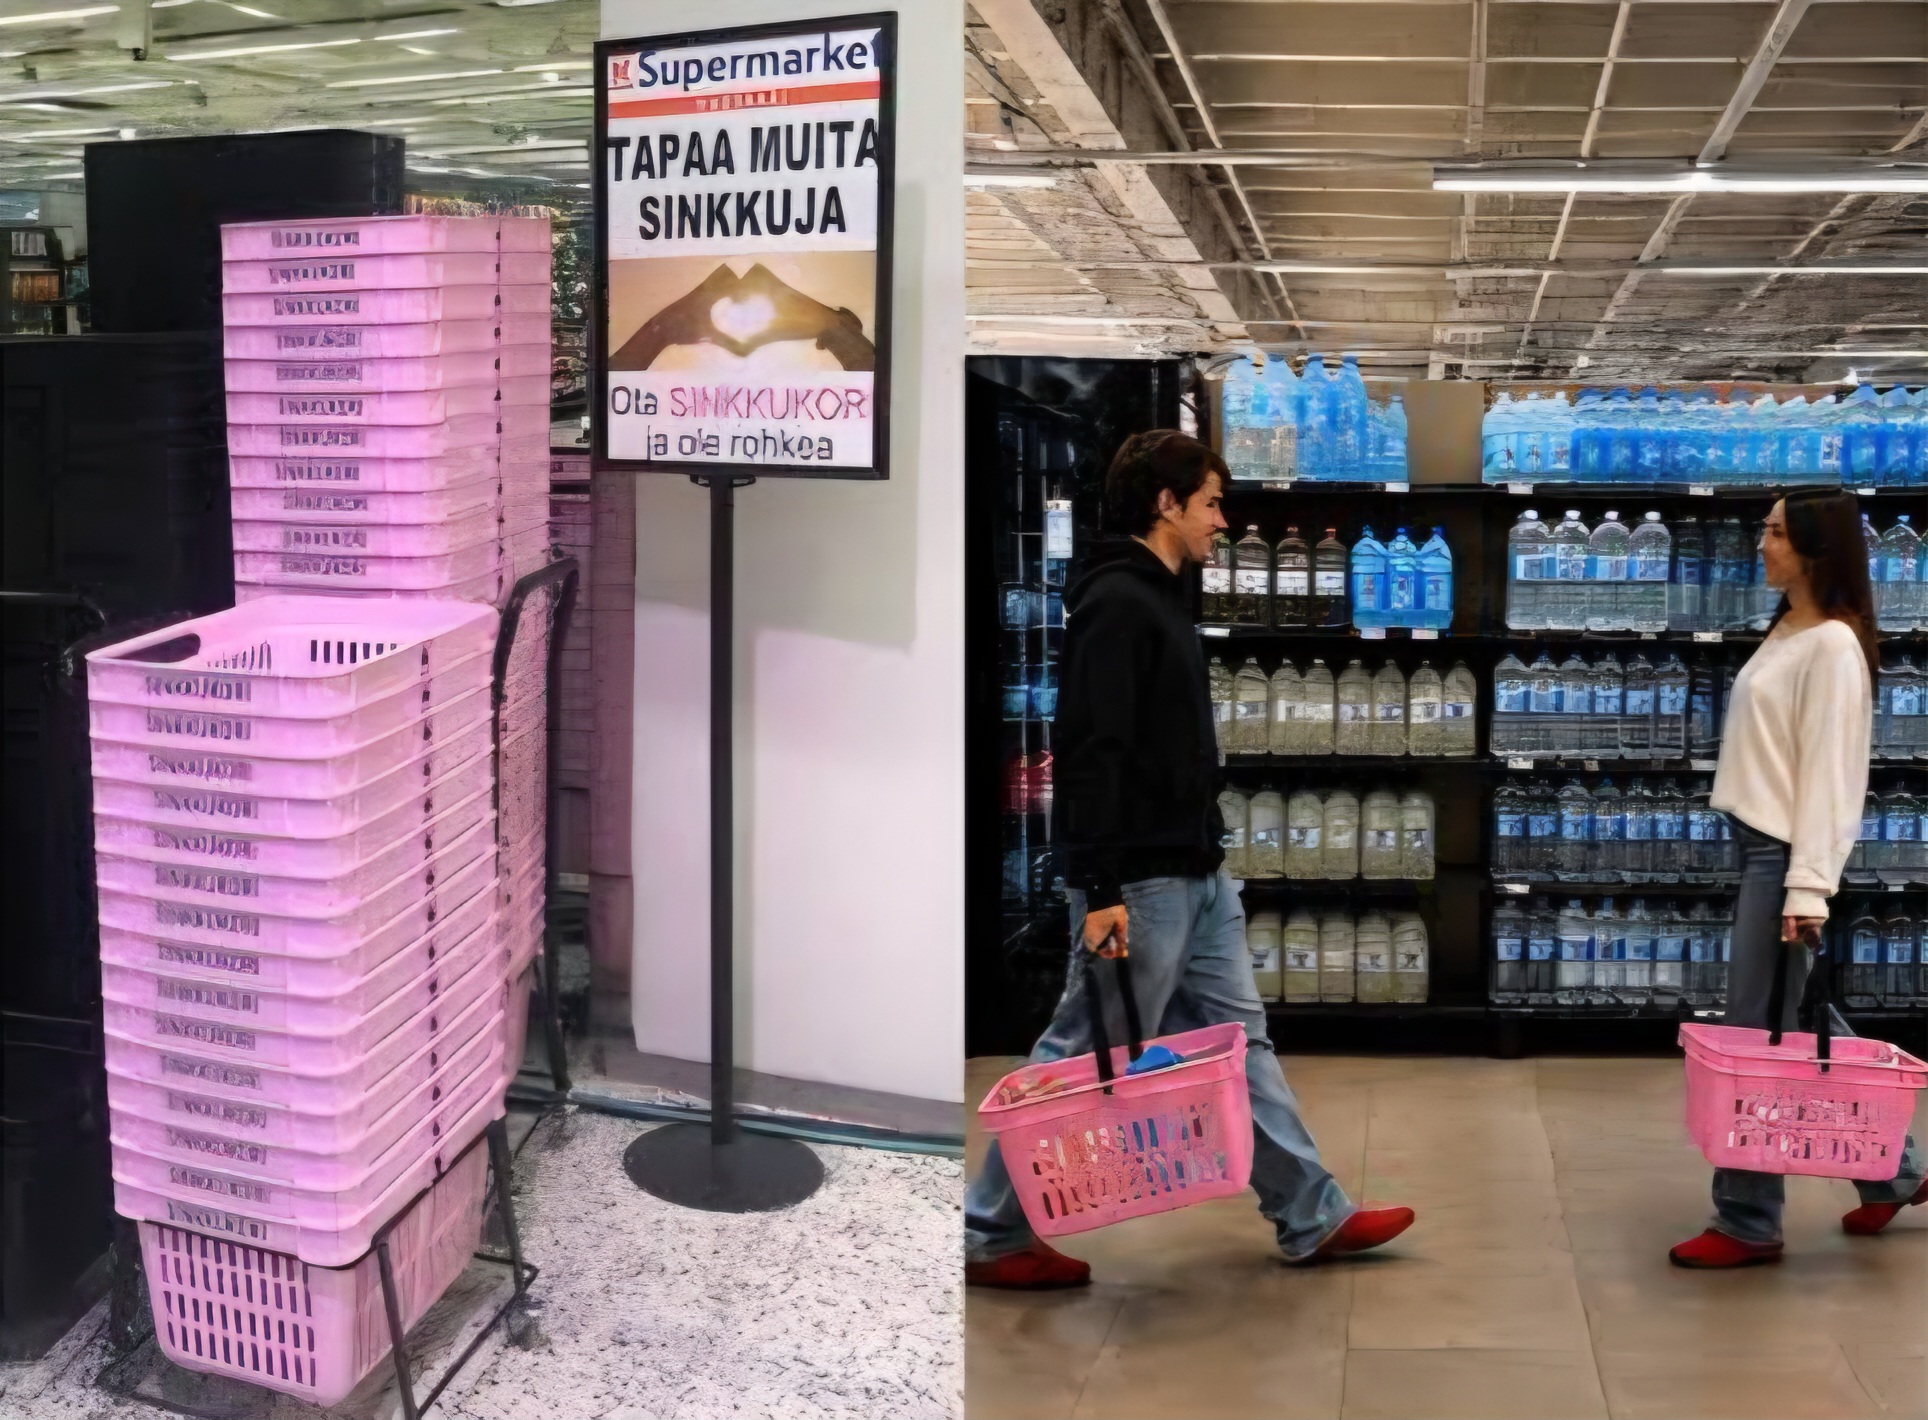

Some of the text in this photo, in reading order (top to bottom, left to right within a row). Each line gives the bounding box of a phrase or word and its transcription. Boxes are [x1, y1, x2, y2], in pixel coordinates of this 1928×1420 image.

[607, 118, 879, 181] TAPAA MUITA
[638, 186, 847, 240] SINKKUJA
